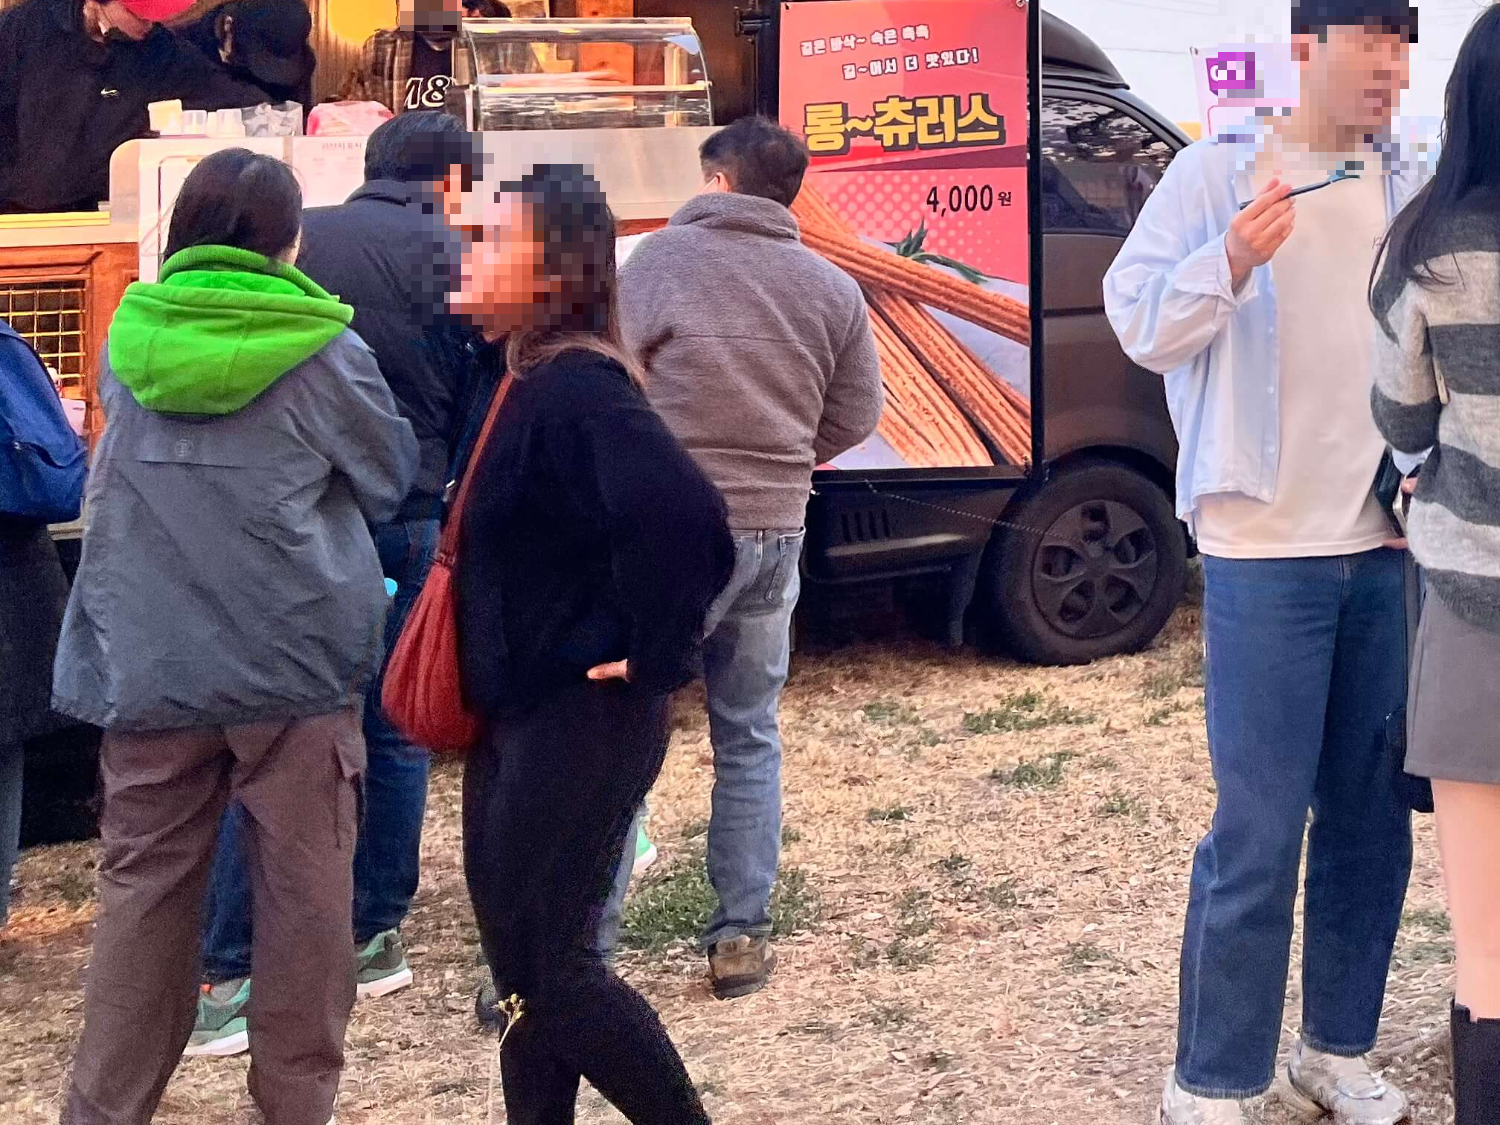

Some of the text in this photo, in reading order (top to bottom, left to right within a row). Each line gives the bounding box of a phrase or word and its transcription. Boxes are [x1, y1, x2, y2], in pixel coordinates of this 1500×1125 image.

[870, 28, 898, 46] 속은
[904, 55, 919, 71] 더
[925, 47, 980, 69] 맛있다!
[803, 93, 1007, 156] 롱~츄러스
[926, 184, 1012, 217] 4,000 원
